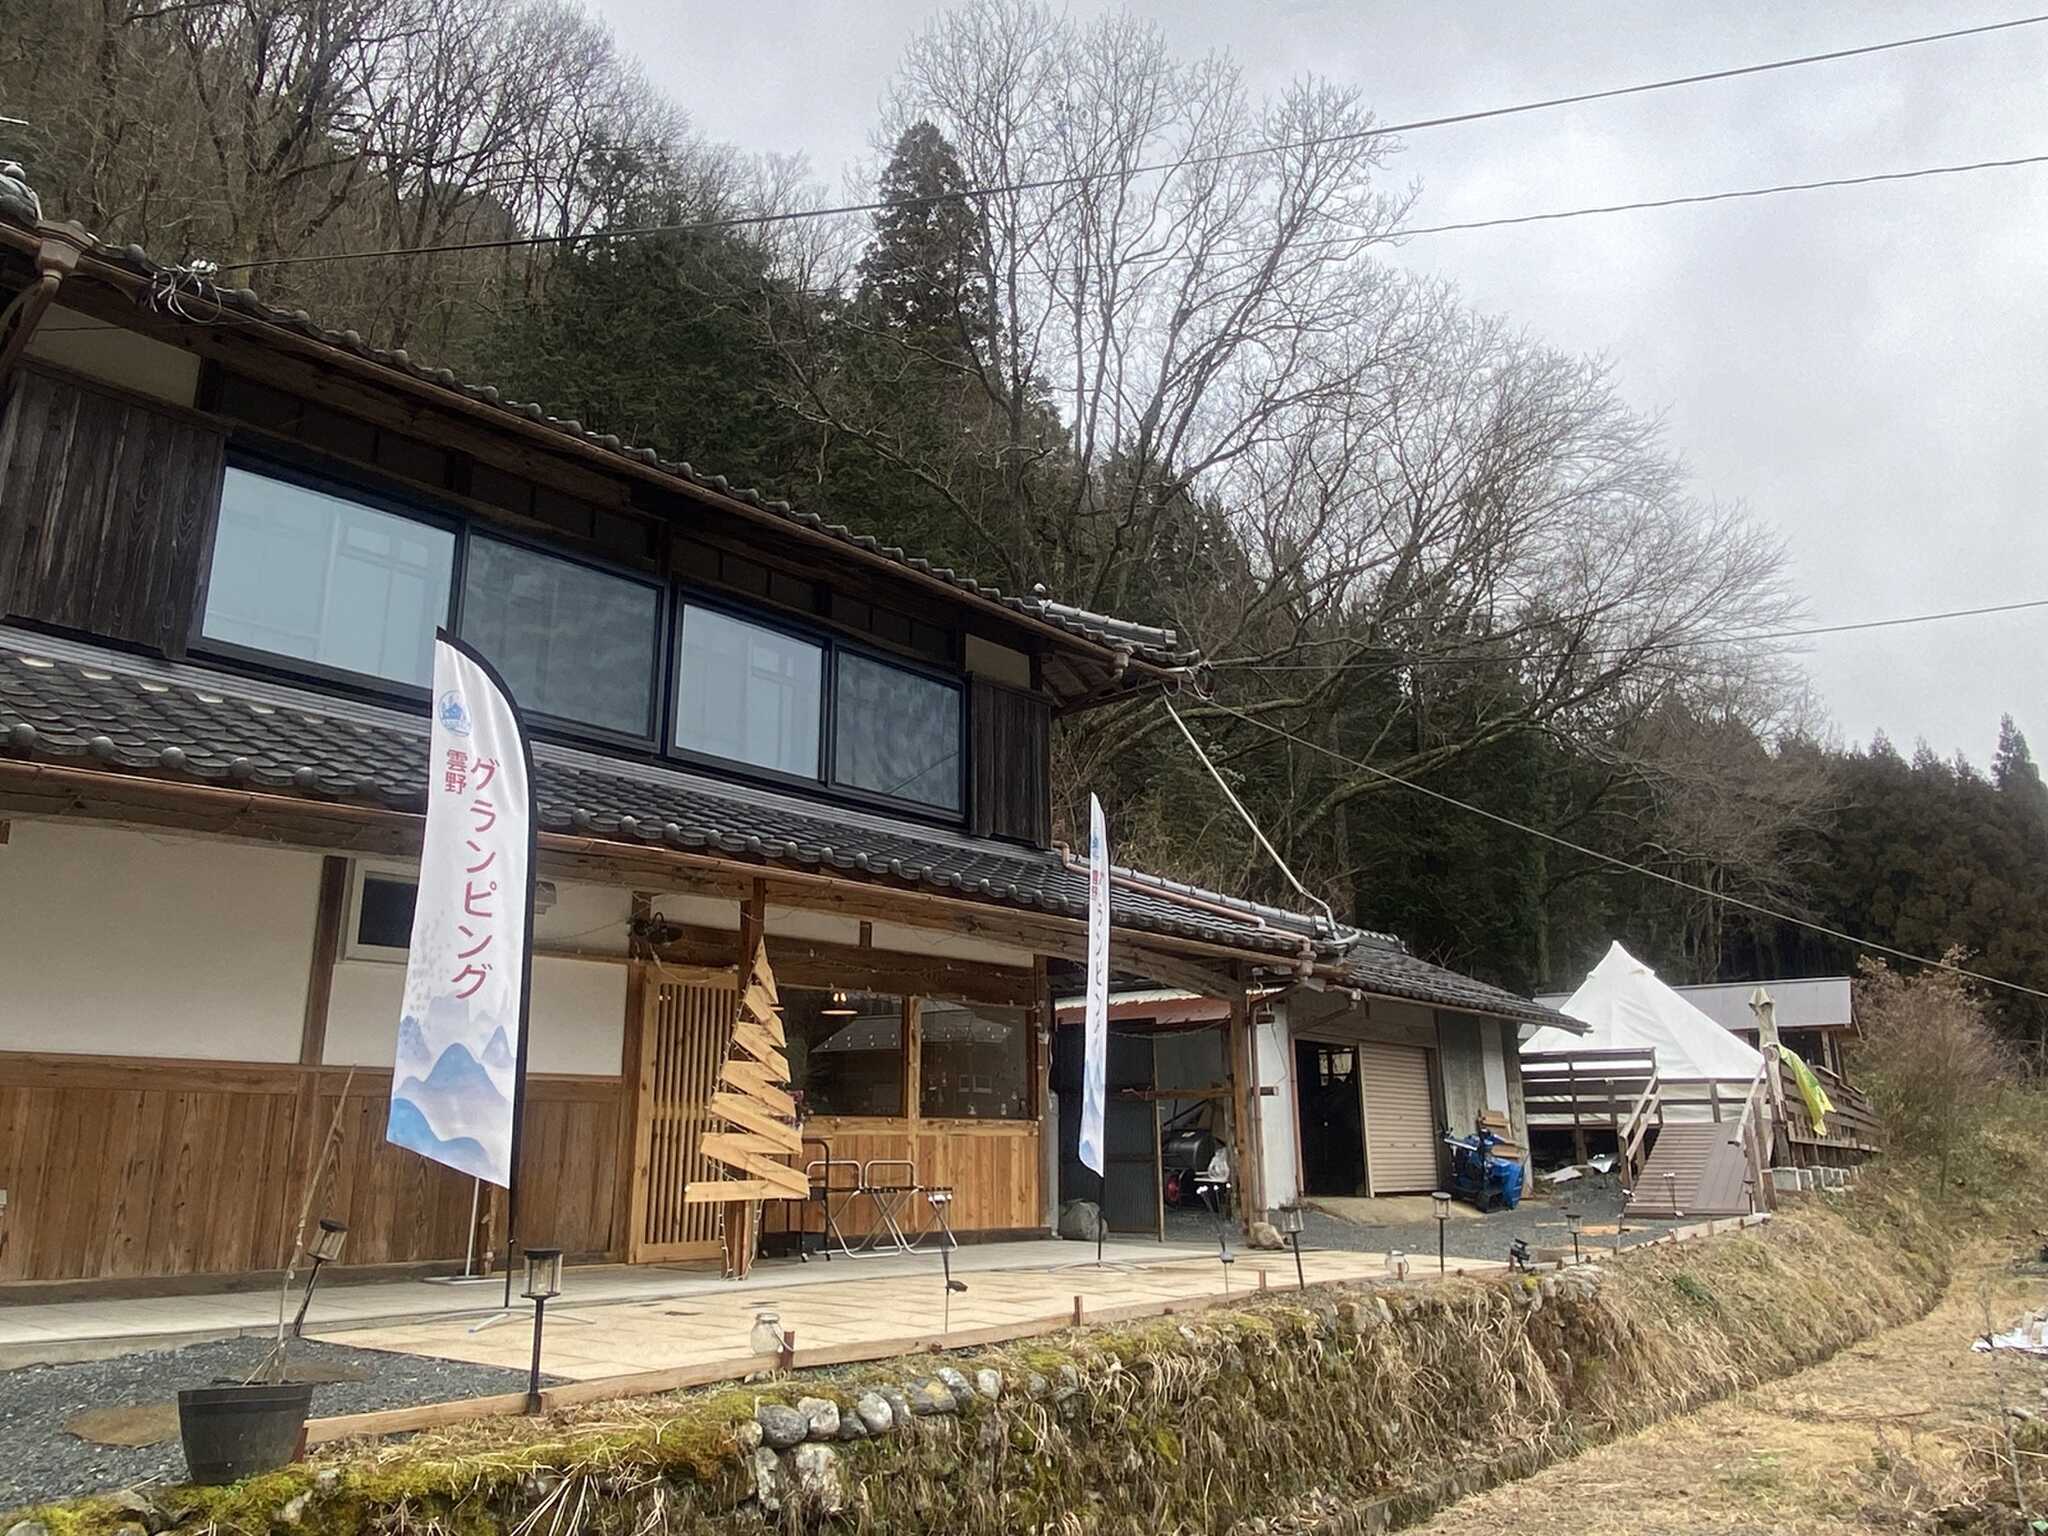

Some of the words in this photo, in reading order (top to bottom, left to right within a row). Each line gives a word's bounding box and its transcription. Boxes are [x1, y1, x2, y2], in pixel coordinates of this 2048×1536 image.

[444, 748, 469, 795] 雲野
[450, 757, 501, 1000] グランピング
